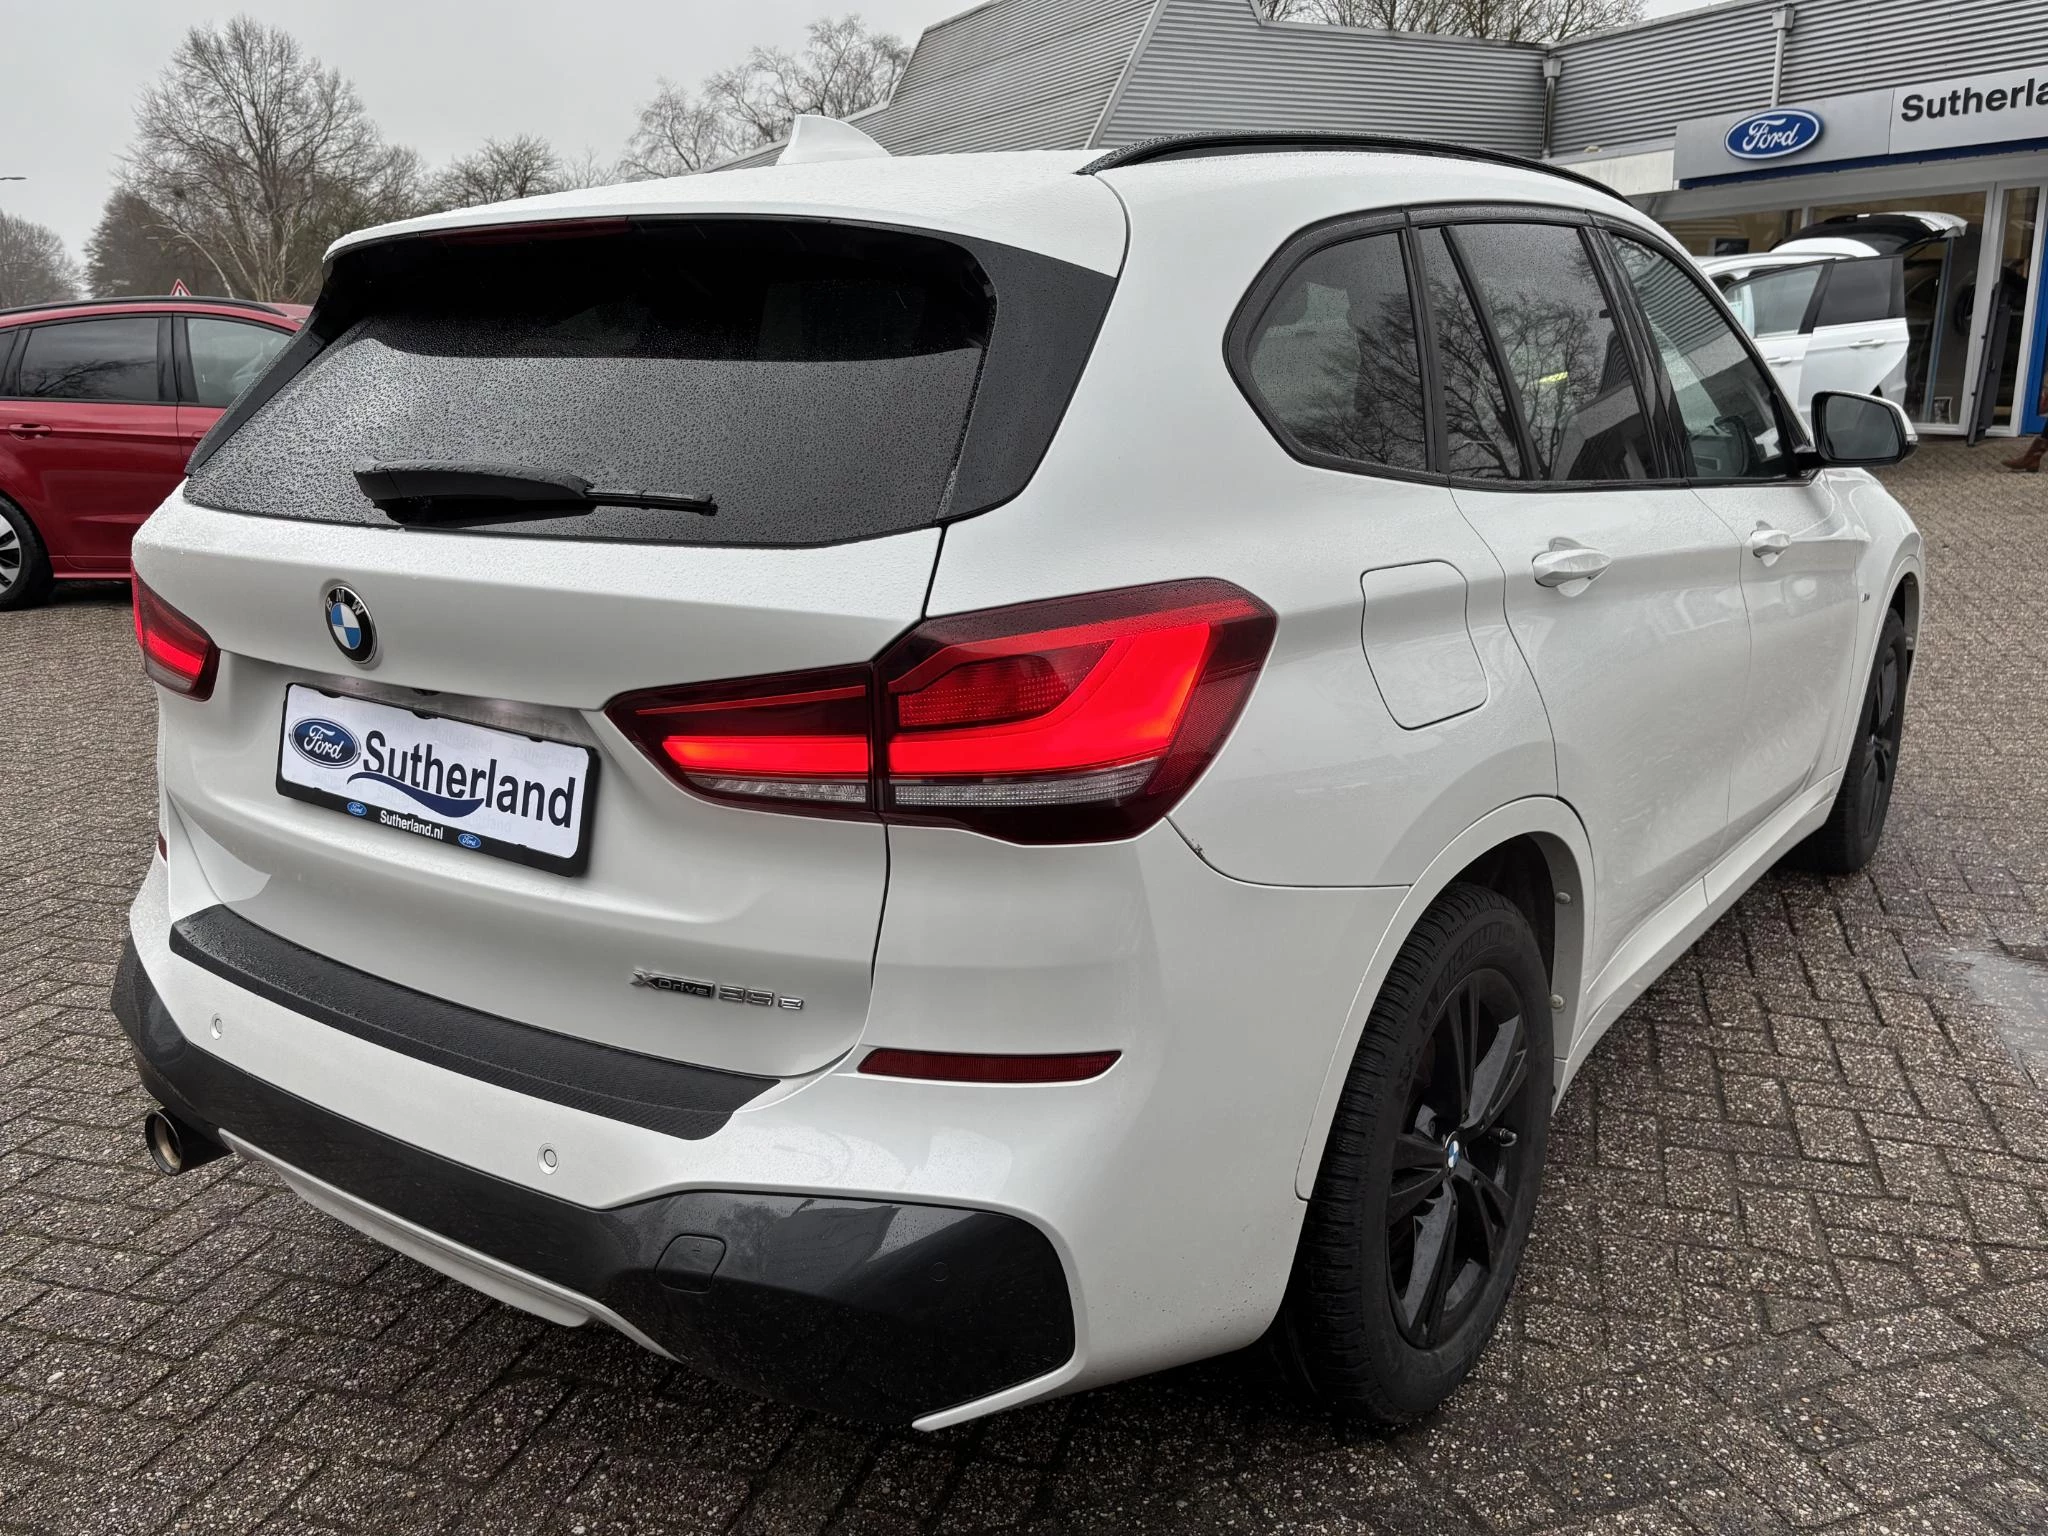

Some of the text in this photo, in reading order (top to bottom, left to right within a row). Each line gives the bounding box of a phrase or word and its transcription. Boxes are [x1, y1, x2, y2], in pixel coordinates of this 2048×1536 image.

[1742, 117, 1801, 151] Ford
[326, 589, 365, 615] BMW
[303, 724, 343, 760] Ford
[363, 730, 577, 828] Sutherland
[380, 810, 444, 840] Sutherland.nl
